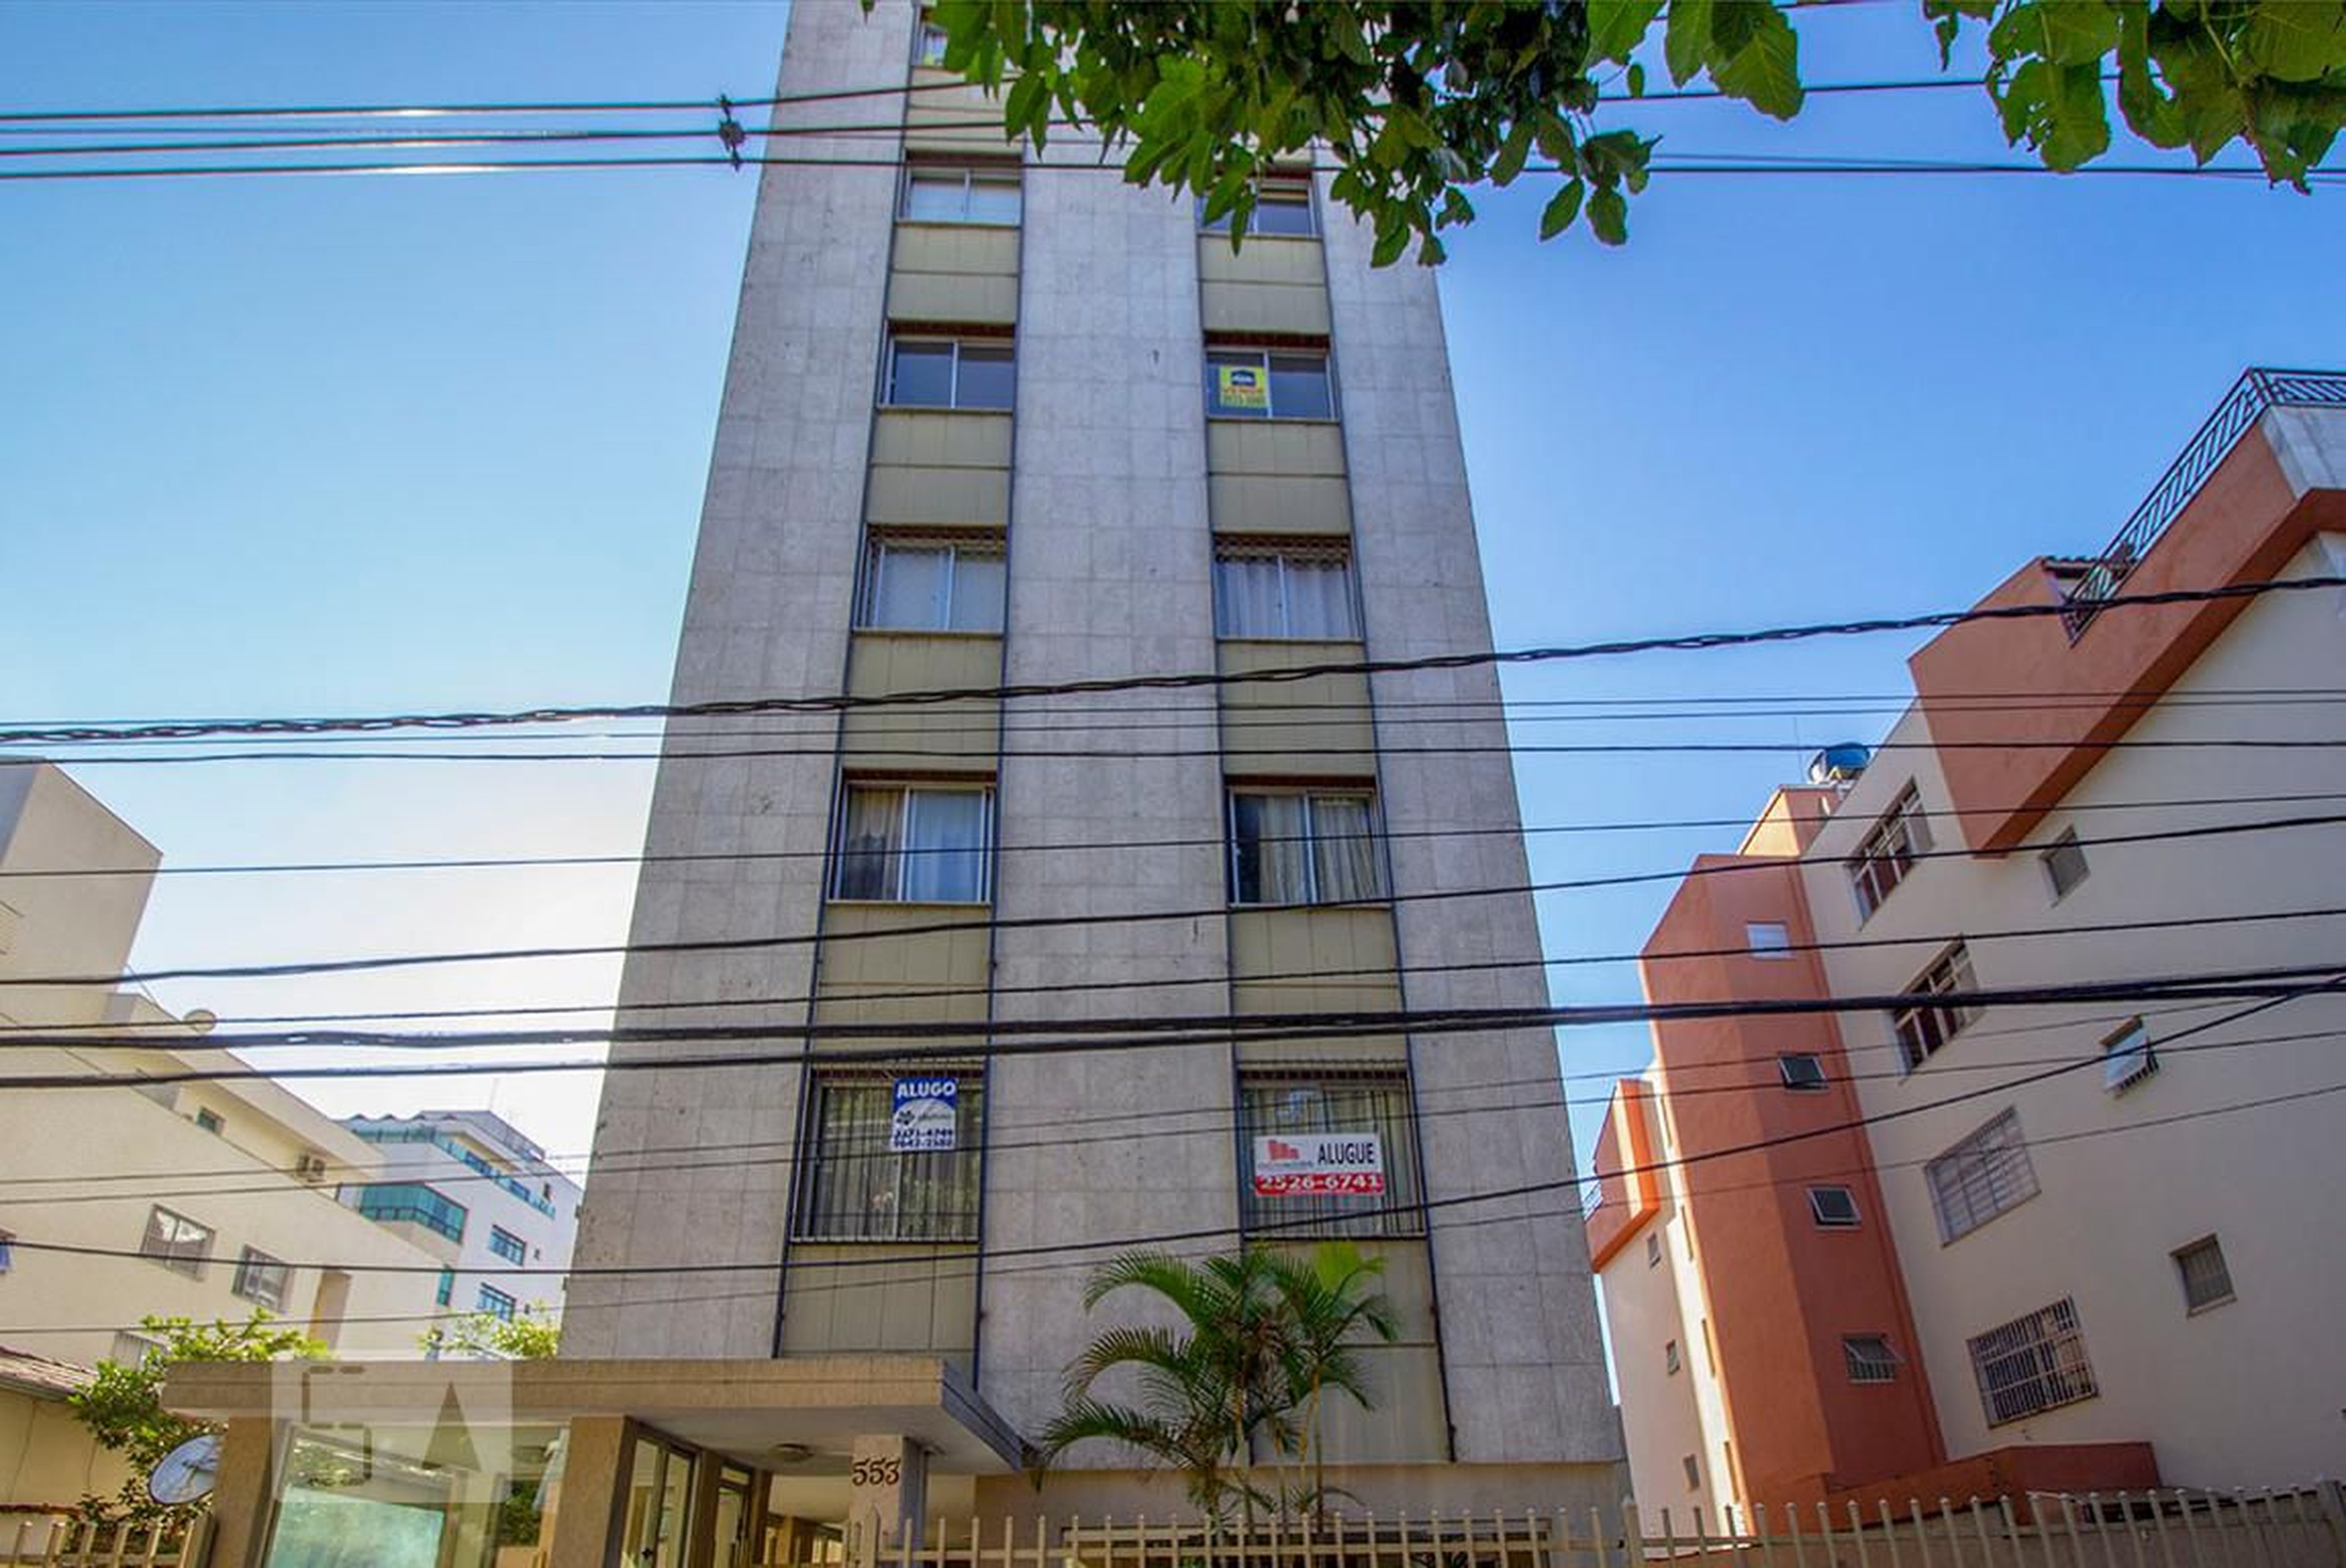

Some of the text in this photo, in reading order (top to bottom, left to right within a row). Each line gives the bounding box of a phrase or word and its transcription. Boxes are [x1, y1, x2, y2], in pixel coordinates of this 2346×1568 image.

[897, 1081, 956, 1098] ALUGO
[1318, 1142, 1375, 1164] ALUGUE
[1260, 1175, 1378, 1189] 2526-6741
[852, 1457, 901, 1486] 553
